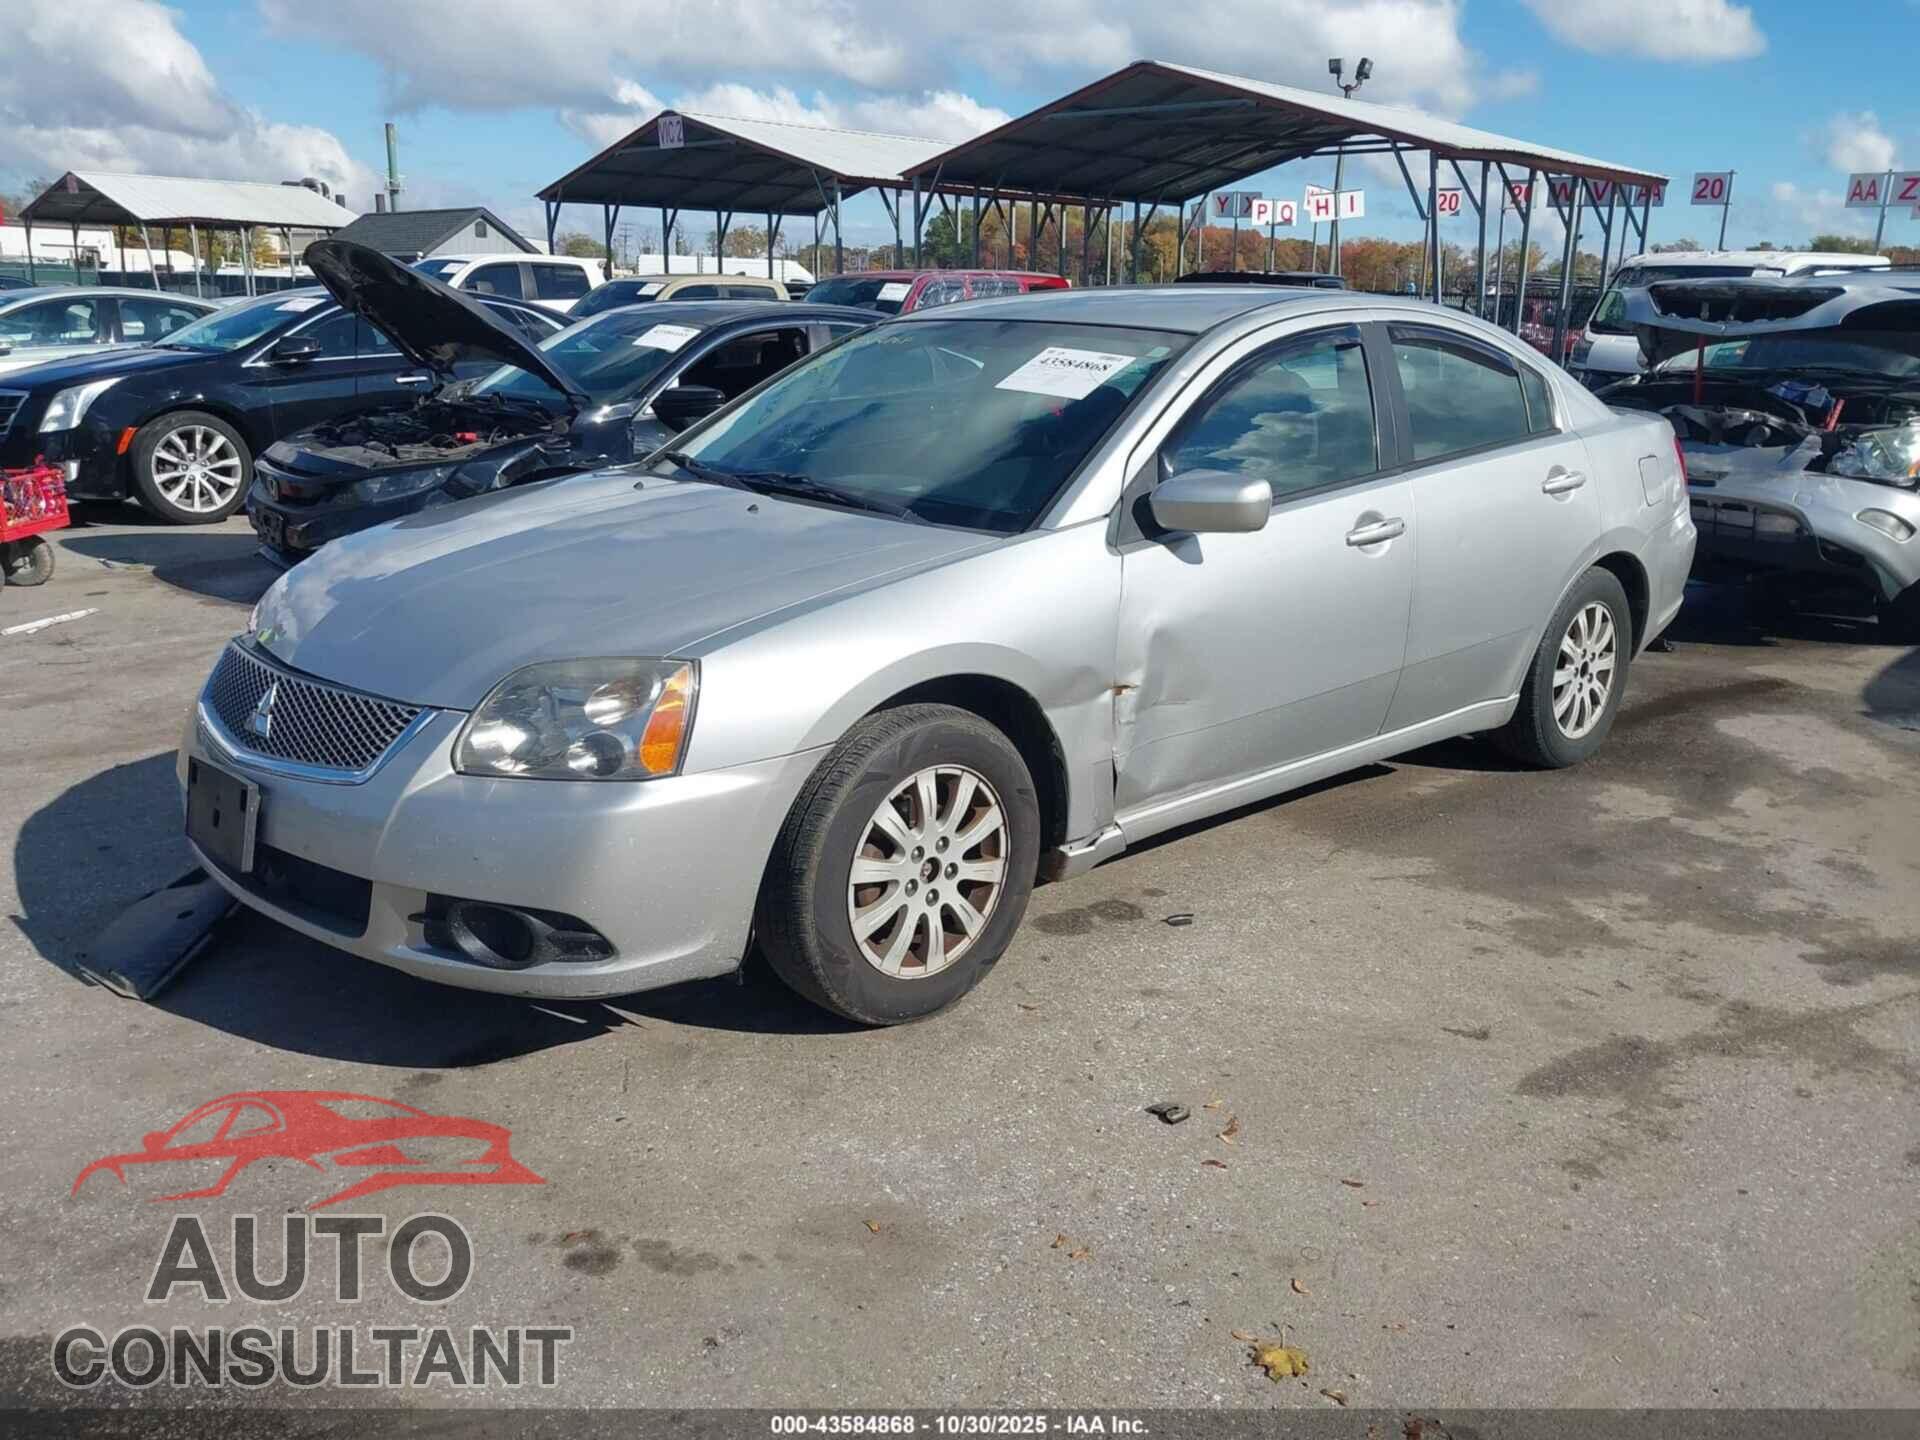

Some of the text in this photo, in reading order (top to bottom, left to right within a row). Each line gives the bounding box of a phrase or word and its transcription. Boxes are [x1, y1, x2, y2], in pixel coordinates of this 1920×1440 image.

[1695, 178, 1724, 200] 20
[1850, 179, 1878, 201] AA
[1898, 177, 1920, 200] Z
[1216, 196, 1229, 213] Y
[1257, 203, 1268, 221] P
[1316, 198, 1329, 216] H
[1439, 193, 1459, 212] 20
